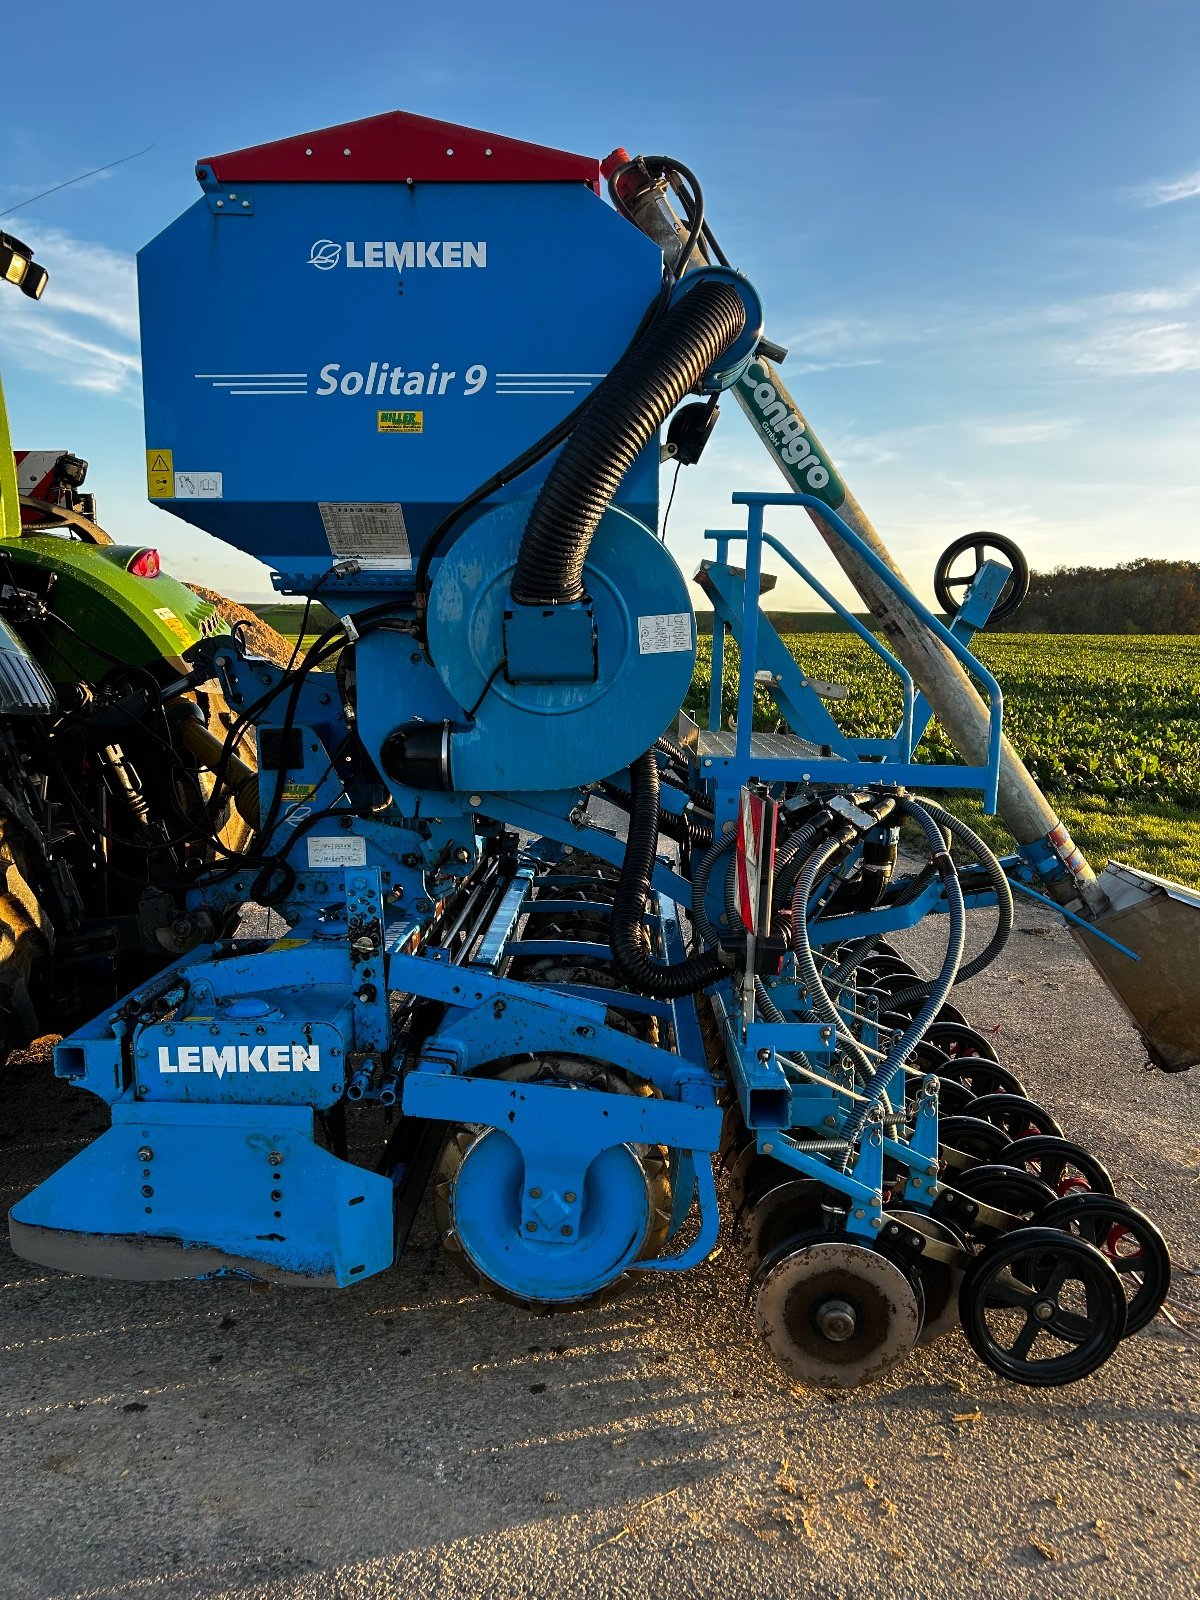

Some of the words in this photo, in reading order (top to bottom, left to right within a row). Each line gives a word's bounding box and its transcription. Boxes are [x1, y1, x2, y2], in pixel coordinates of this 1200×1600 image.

[346, 241, 487, 274] LEMKEN
[316, 362, 456, 395] Solitair
[463, 364, 488, 395] 9
[742, 356, 830, 489] CanAgro
[762, 421, 780, 447] GmbH
[158, 1045, 320, 1080] LEMKEN
